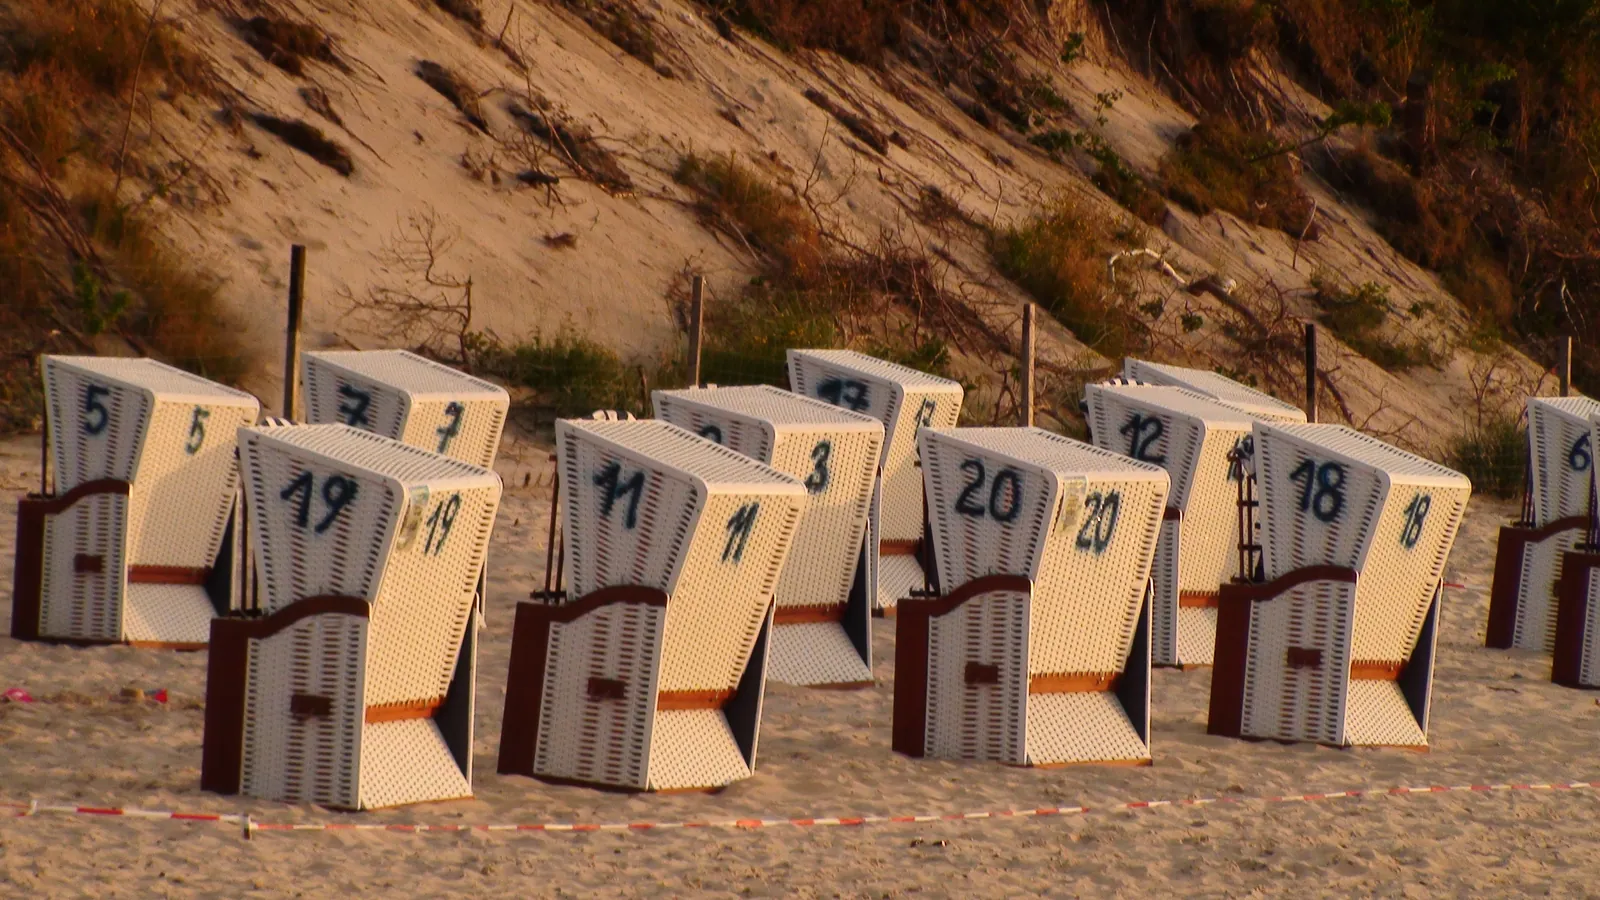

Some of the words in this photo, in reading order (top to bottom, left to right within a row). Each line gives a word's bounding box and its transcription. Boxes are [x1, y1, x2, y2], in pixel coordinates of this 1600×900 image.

[84, 384, 109, 435] 5
[185, 406, 209, 454] 5
[338, 384, 371, 426] 7
[437, 402, 463, 452] 7
[807, 439, 831, 494] 3
[1120, 415, 1166, 463] 12
[1568, 432, 1591, 471] 6
[280, 471, 359, 534] 19
[955, 459, 1022, 522] 20
[1289, 459, 1345, 522] 18
[424, 492, 461, 556] 19
[722, 502, 758, 563] 11
[1076, 488, 1120, 555] 20
[1401, 491, 1431, 549] 18
